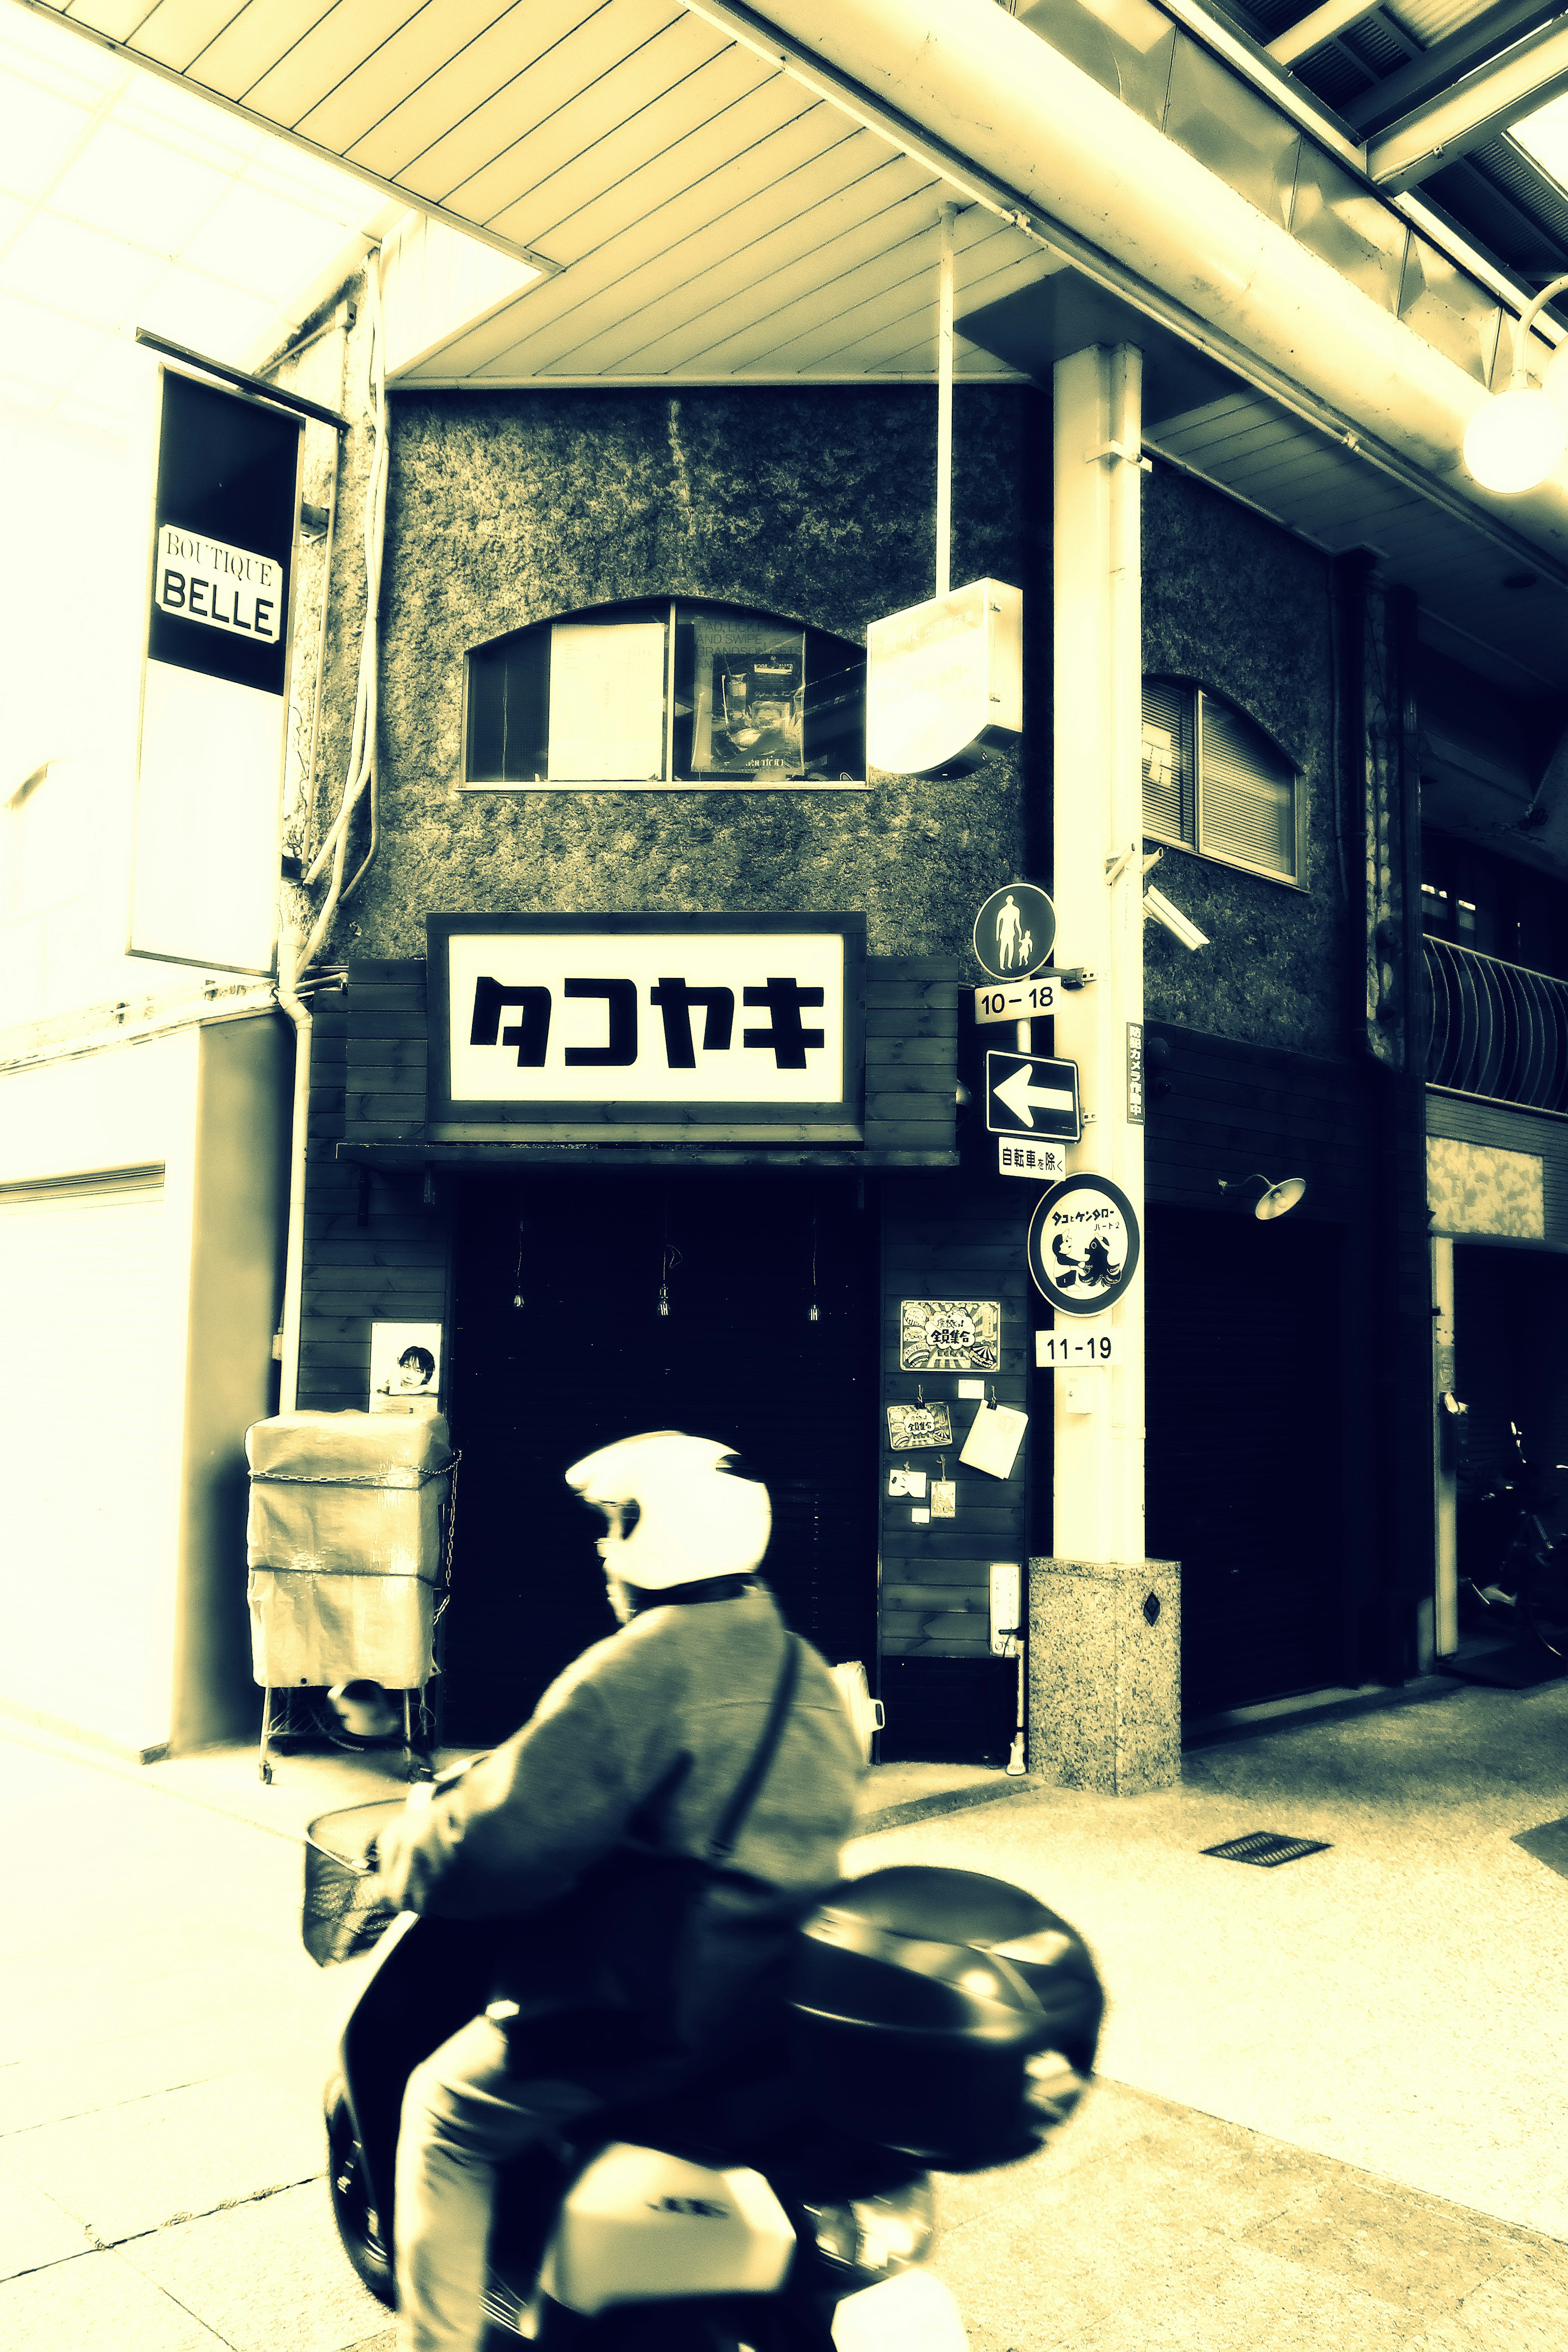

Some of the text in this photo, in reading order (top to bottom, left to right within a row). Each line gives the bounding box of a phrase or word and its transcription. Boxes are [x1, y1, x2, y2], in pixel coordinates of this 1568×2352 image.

[166, 532, 272, 586] BOUTIQUE
[163, 568, 274, 636] BELLE
[695, 634, 722, 644] AND
[470, 976, 824, 1069] タコヤキ
[1129, 1025, 1142, 1116] 防犯カメラ作動中
[1003, 1147, 1063, 1172] 自転車を除く
[1052, 1209, 1114, 1226] タコとケンタロー
[931, 1329, 971, 1344] 全員集合
